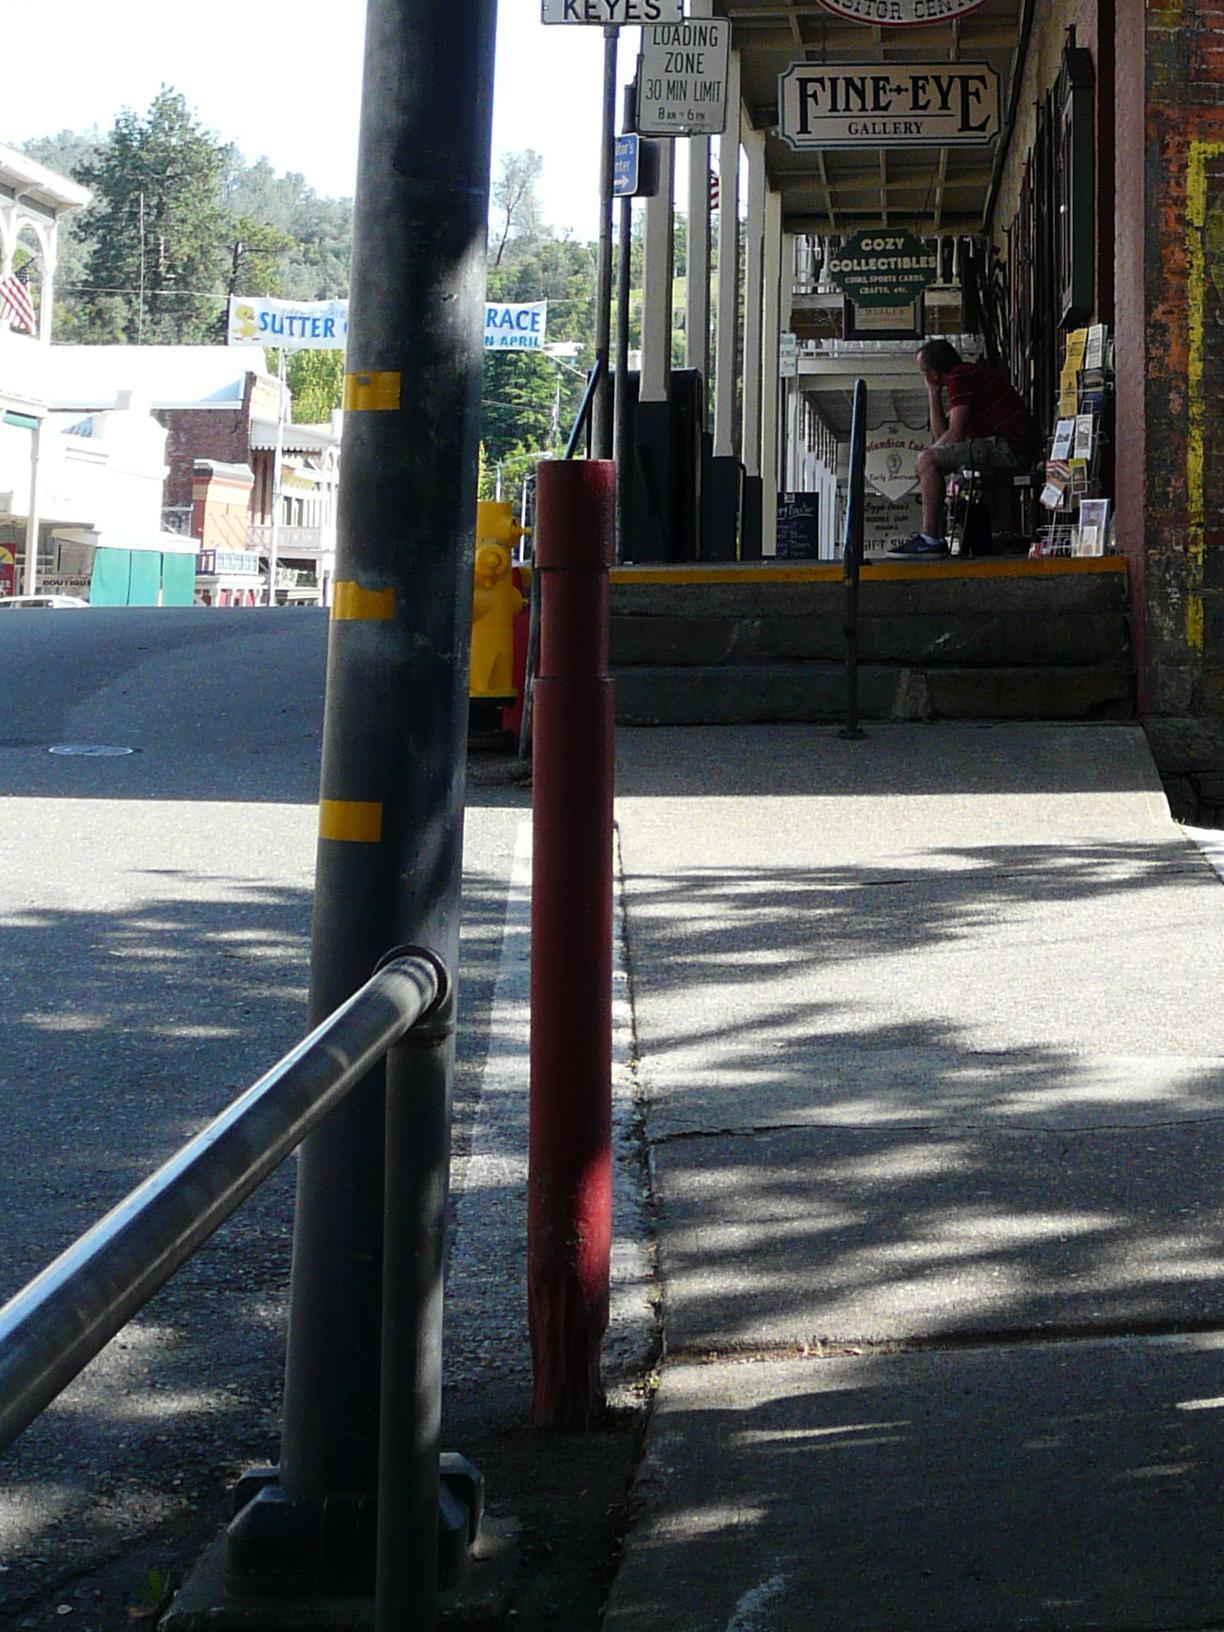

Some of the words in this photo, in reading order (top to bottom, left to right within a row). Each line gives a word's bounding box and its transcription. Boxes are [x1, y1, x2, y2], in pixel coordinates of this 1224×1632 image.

[652, 24, 719, 48] LOADING
[664, 51, 705, 75] ZONE
[645, 78, 662, 101] 30
[666, 79, 688, 102] MIN
[693, 80, 722, 103] LIMIT
[848, 120, 924, 136] GALLERY
[860, 237, 906, 252] COZY
[829, 255, 937, 272] COLLECTIBLES
[258, 311, 336, 338] SUTTER
[485, 308, 541, 333] RACE
[499, 335, 541, 348] APRIL
